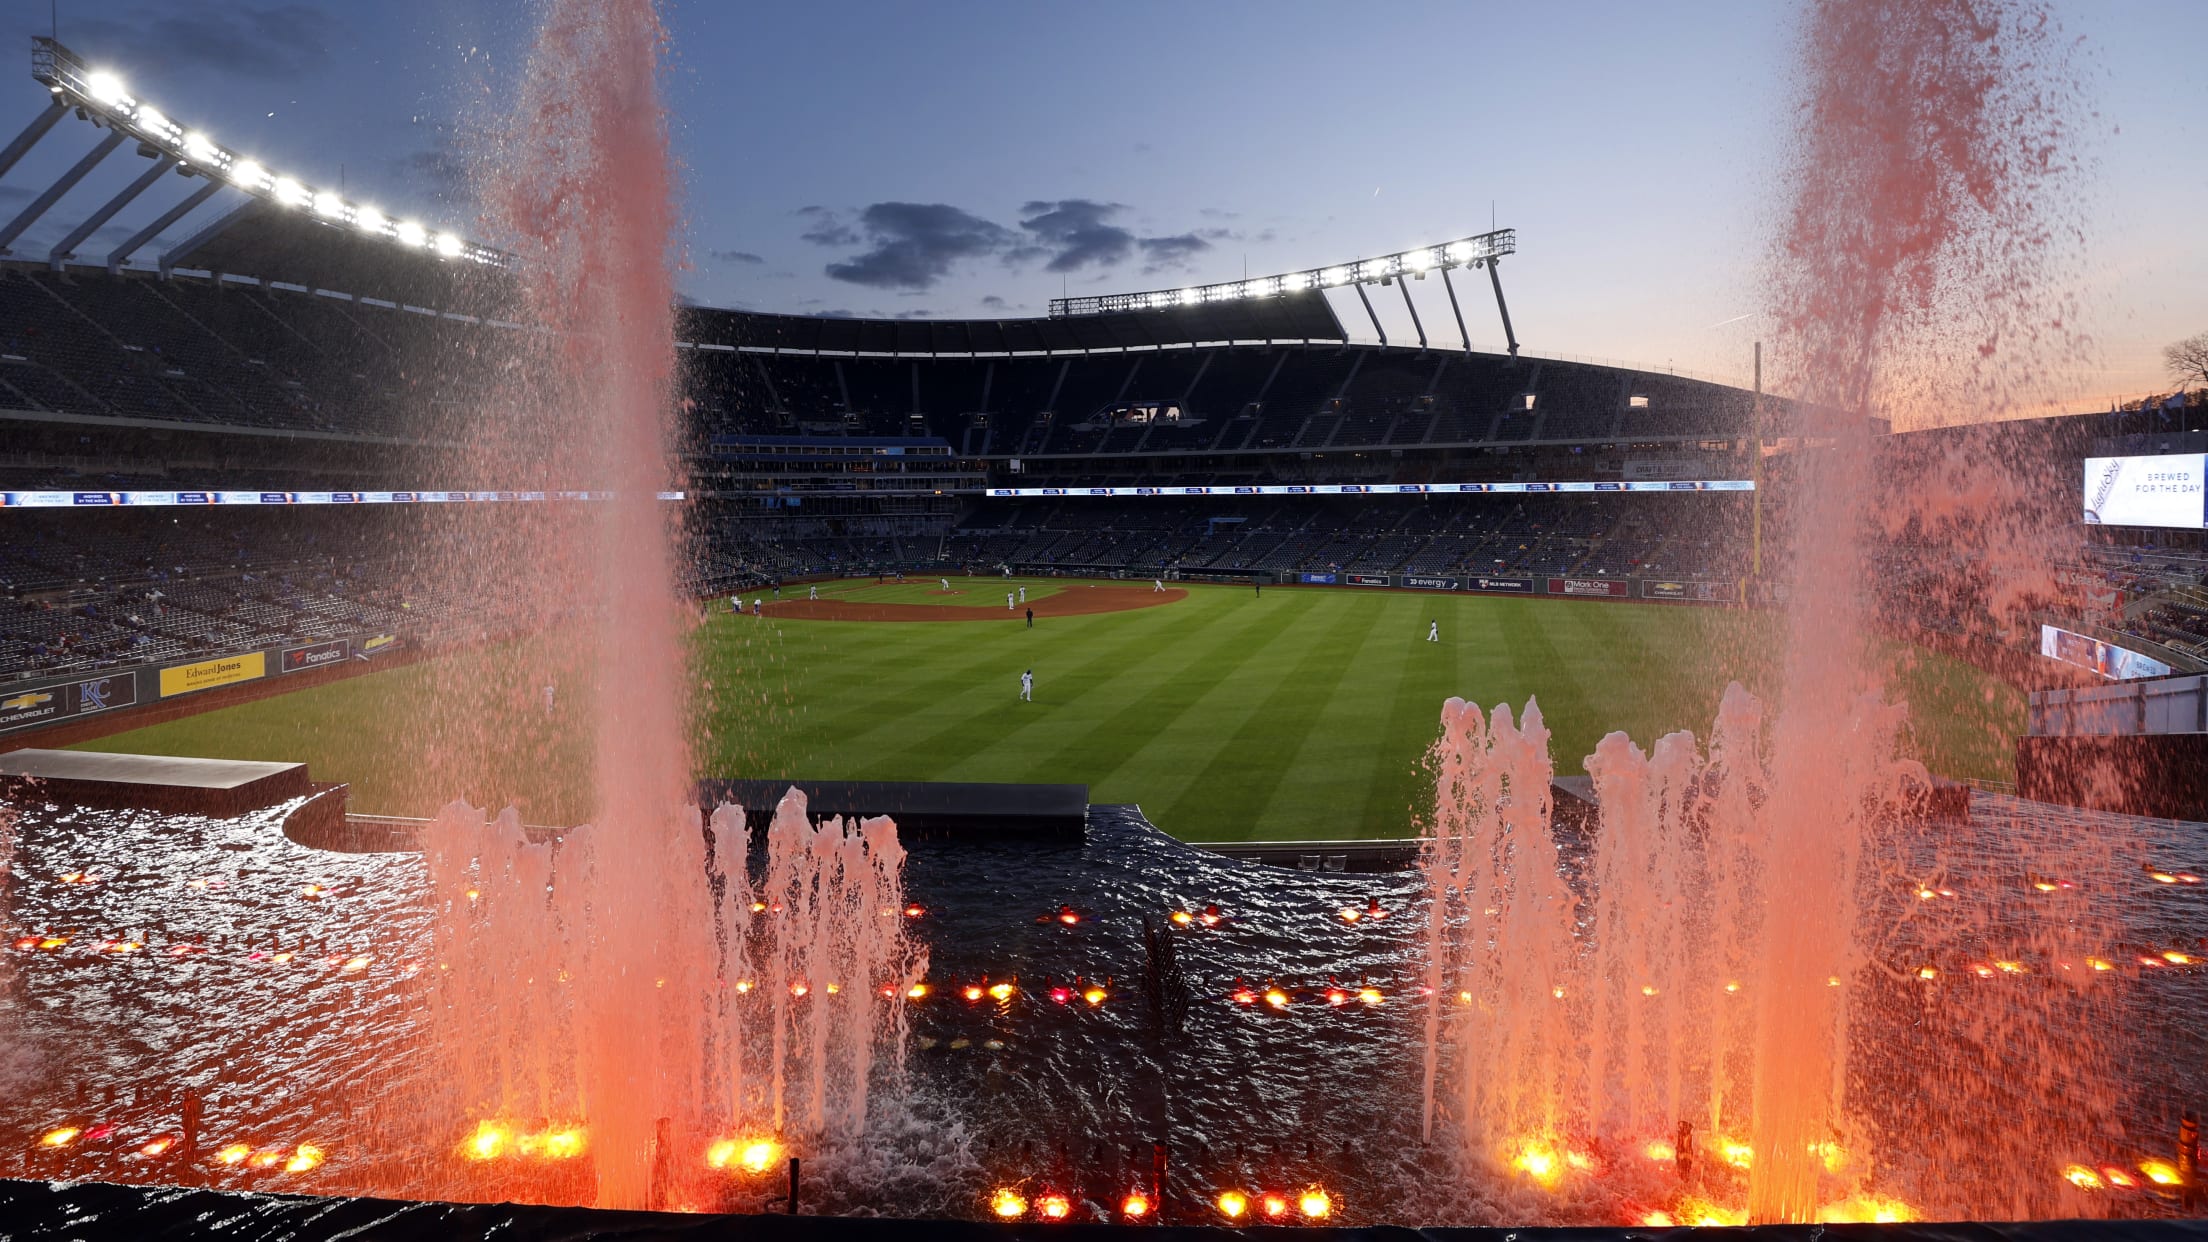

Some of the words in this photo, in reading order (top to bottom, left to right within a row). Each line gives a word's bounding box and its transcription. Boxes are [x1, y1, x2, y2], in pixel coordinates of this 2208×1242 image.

[2147, 472, 2190, 481] BREWED
[2136, 484, 2156, 493] FOR
[2160, 484, 2178, 493] THE
[2181, 484, 2201, 493] DAY
[1418, 579, 1447, 588] evergy
[306, 649, 341, 664] Fanatics
[80, 679, 110, 708] KC
[0, 707, 55, 723] CHEVROLET
